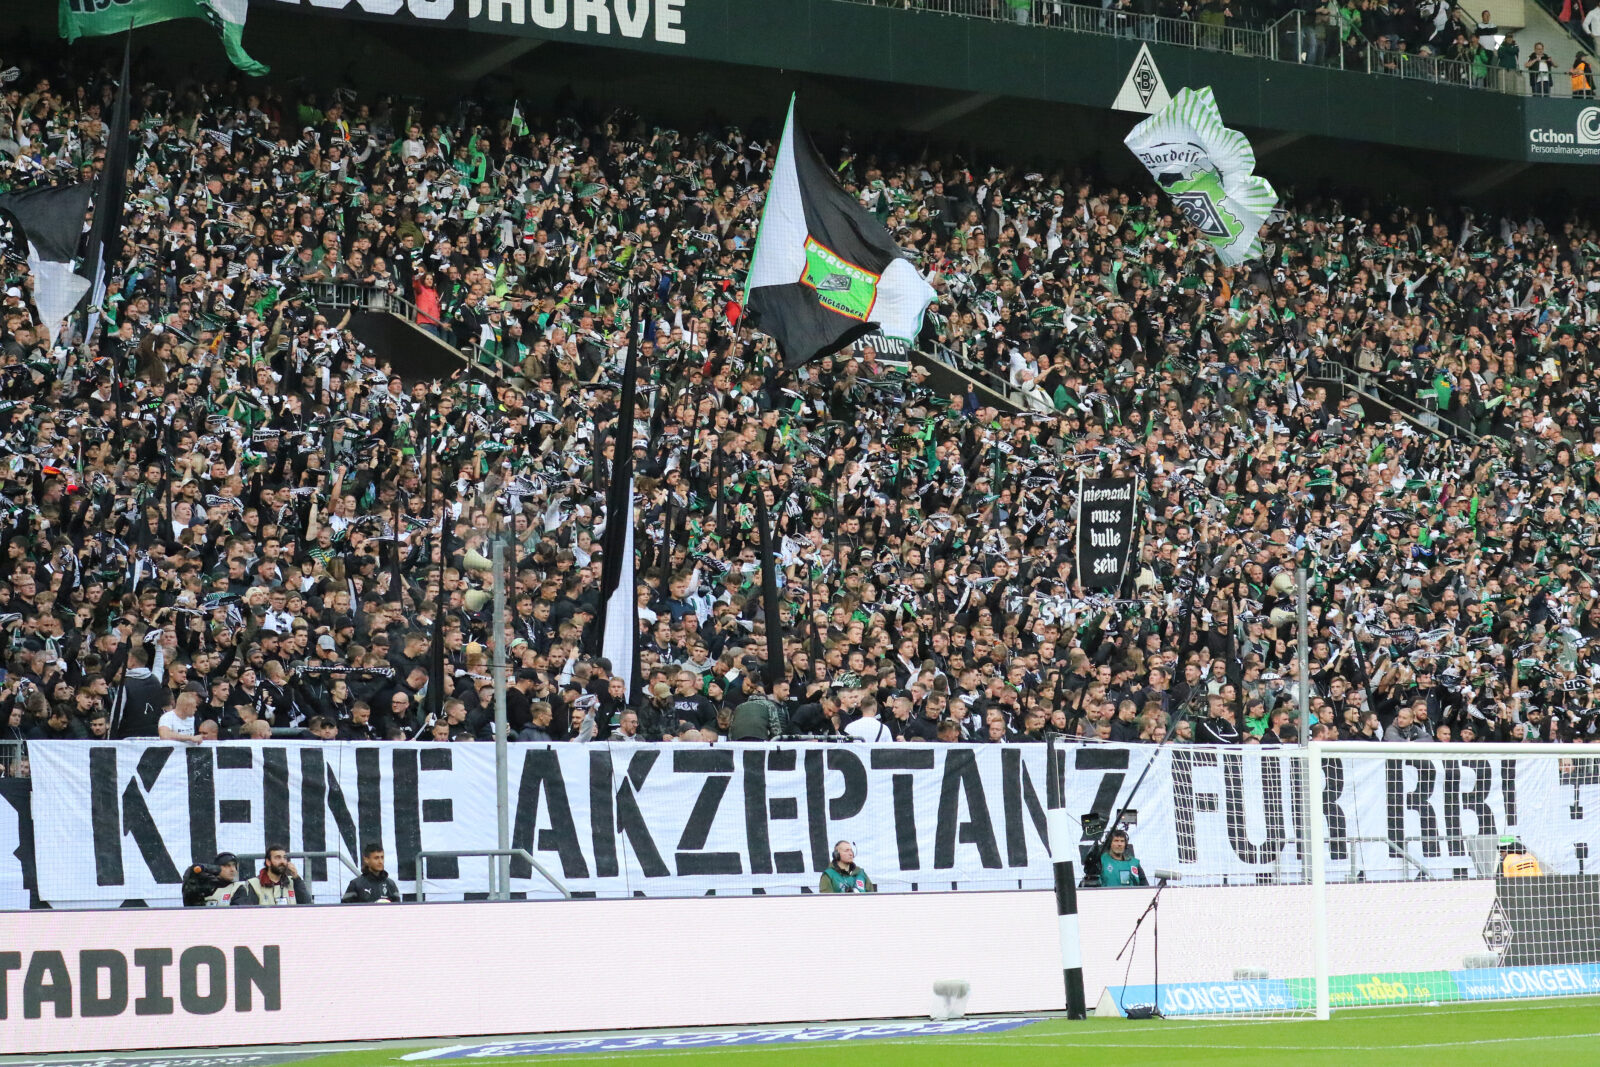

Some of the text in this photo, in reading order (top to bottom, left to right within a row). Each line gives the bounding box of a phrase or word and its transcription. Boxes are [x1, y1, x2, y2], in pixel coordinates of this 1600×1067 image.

[1530, 128, 1574, 144] Cichon
[1083, 483, 1131, 502] niemand
[1091, 509, 1121, 524] muss
[1090, 527, 1121, 547] bulle
[1093, 553, 1118, 574] sein
[90, 746, 459, 887] KEINE
[510, 747, 1135, 880] AKZEPTANZ
[1499, 968, 1588, 994] JONGEN
[1164, 984, 1264, 1012] JONGEN
